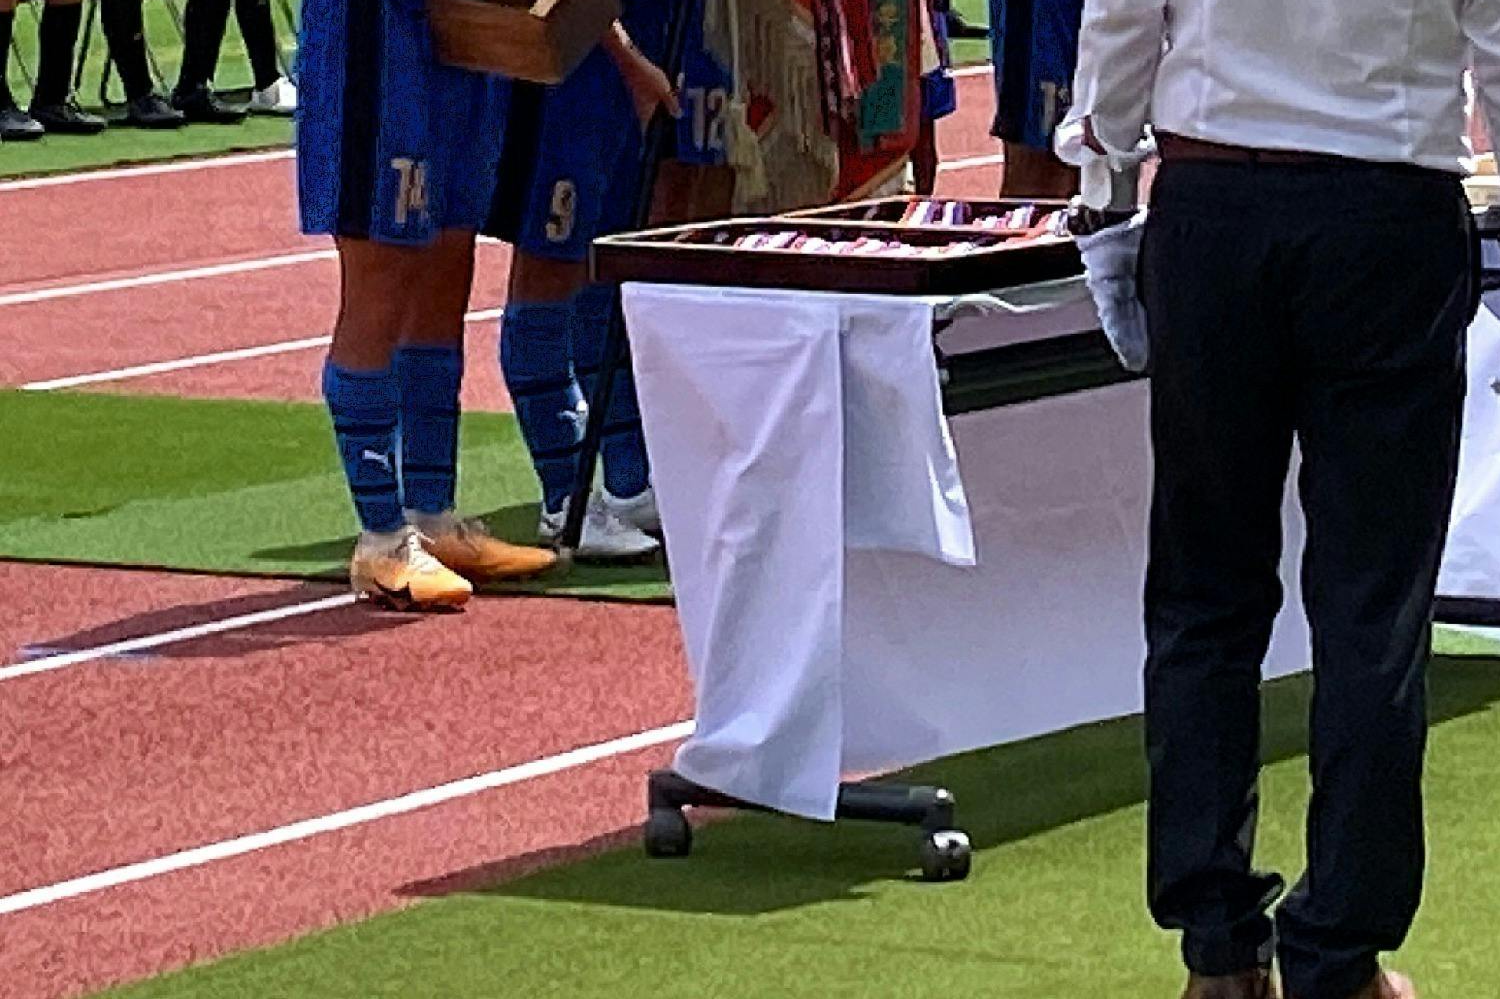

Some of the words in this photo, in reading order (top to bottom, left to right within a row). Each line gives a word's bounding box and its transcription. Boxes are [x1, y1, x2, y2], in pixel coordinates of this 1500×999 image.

[687, 87, 727, 152] 12
[391, 157, 429, 224] 14
[545, 180, 576, 242] 9
